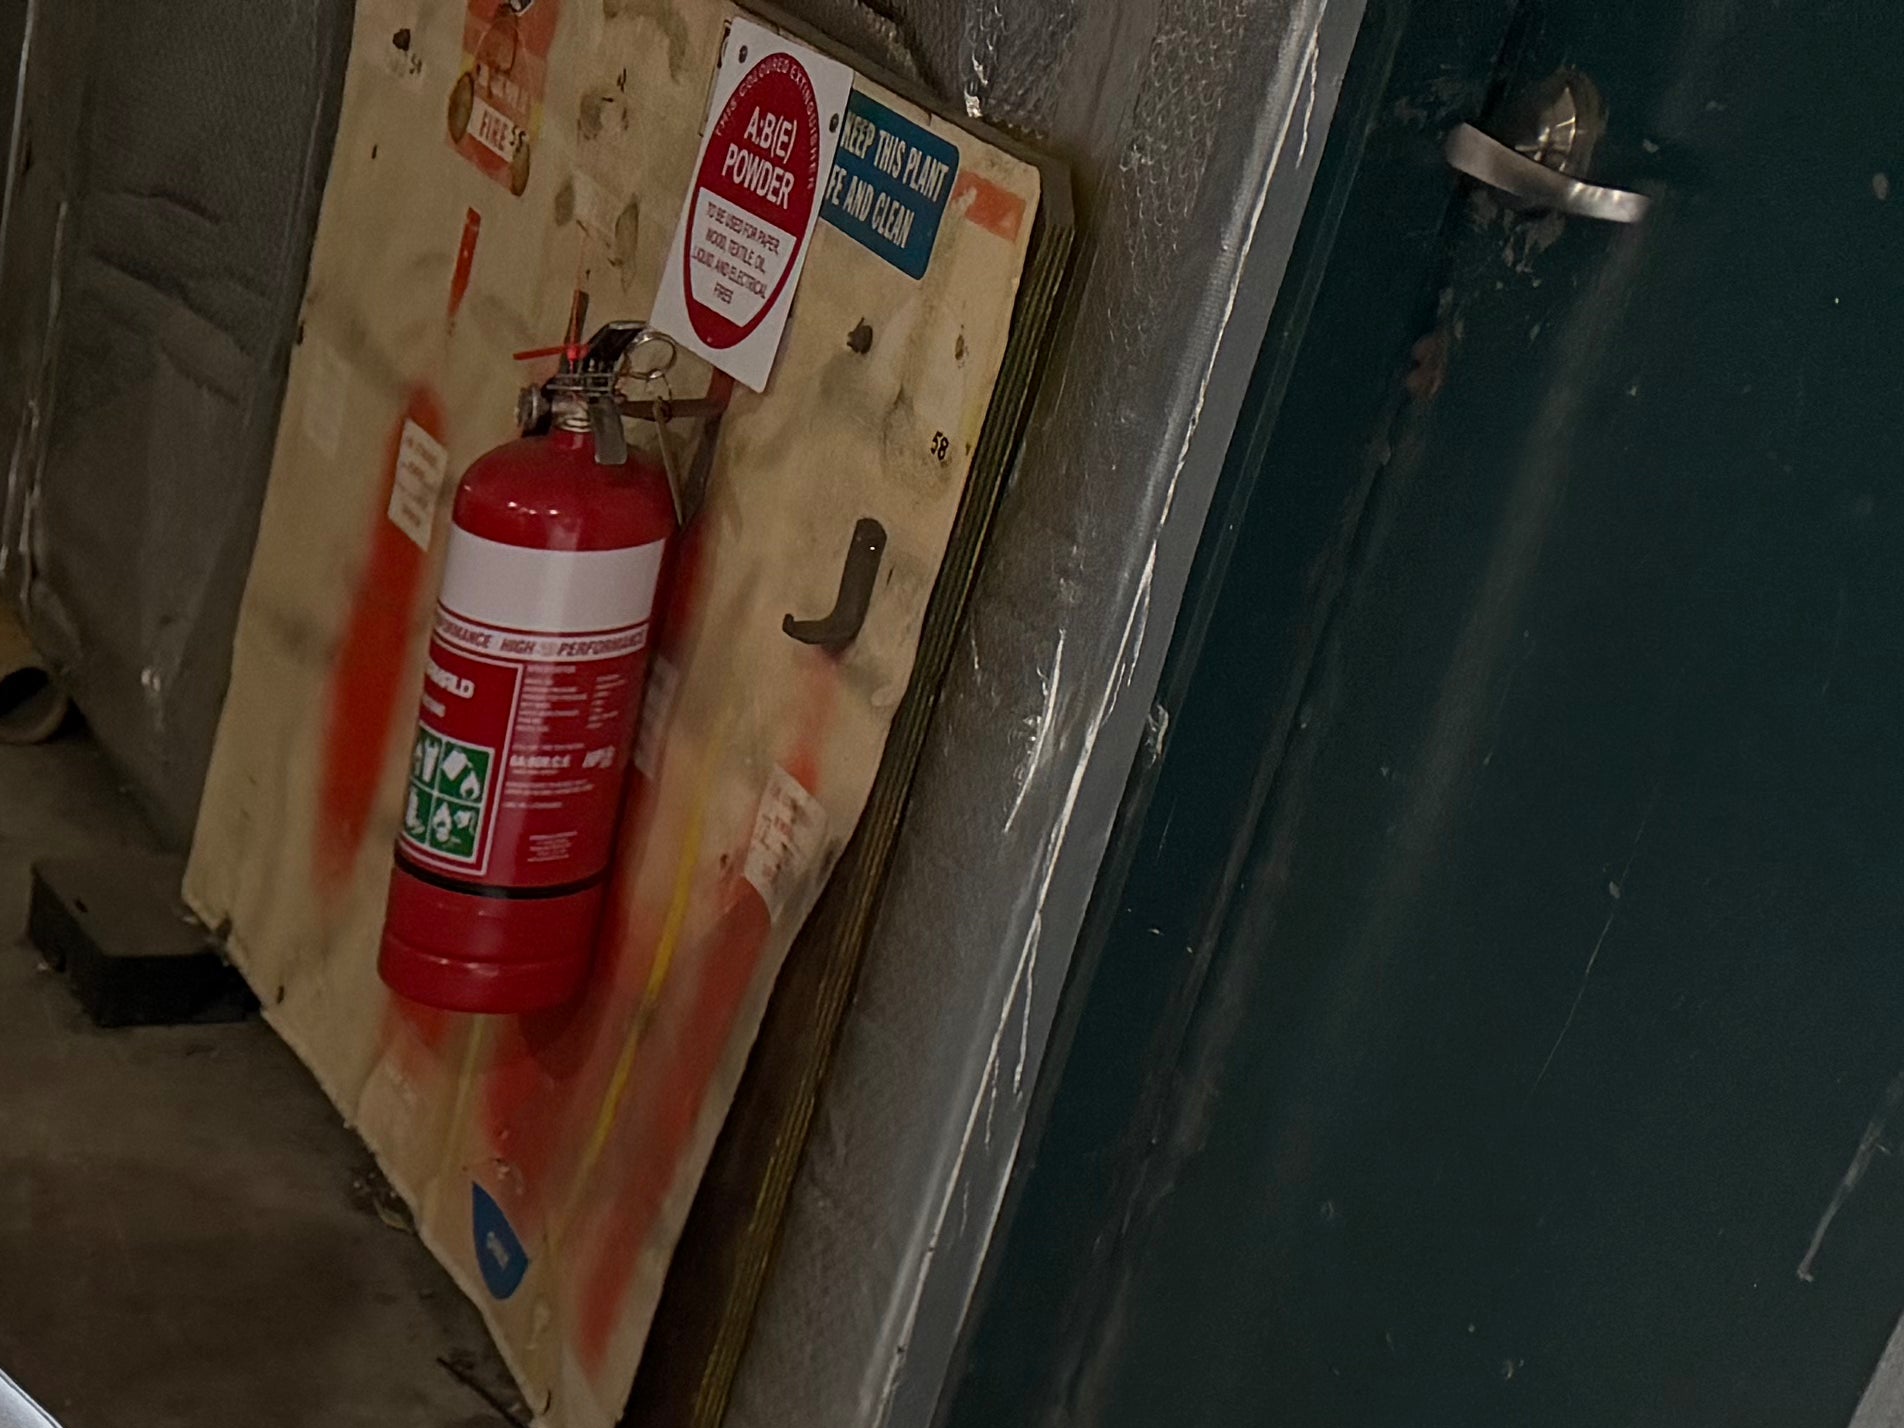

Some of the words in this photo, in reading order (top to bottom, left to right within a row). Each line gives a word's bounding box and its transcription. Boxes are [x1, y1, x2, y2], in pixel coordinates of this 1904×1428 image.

[721, 142, 795, 210] POWDER
[840, 111, 876, 159] KEEP
[873, 129, 907, 179] THIS
[902, 147, 950, 203] PLANT
[826, 164, 848, 206] FE
[842, 175, 875, 222] AND
[871, 191, 916, 249] CLEAN
[930, 430, 949, 461] 58
